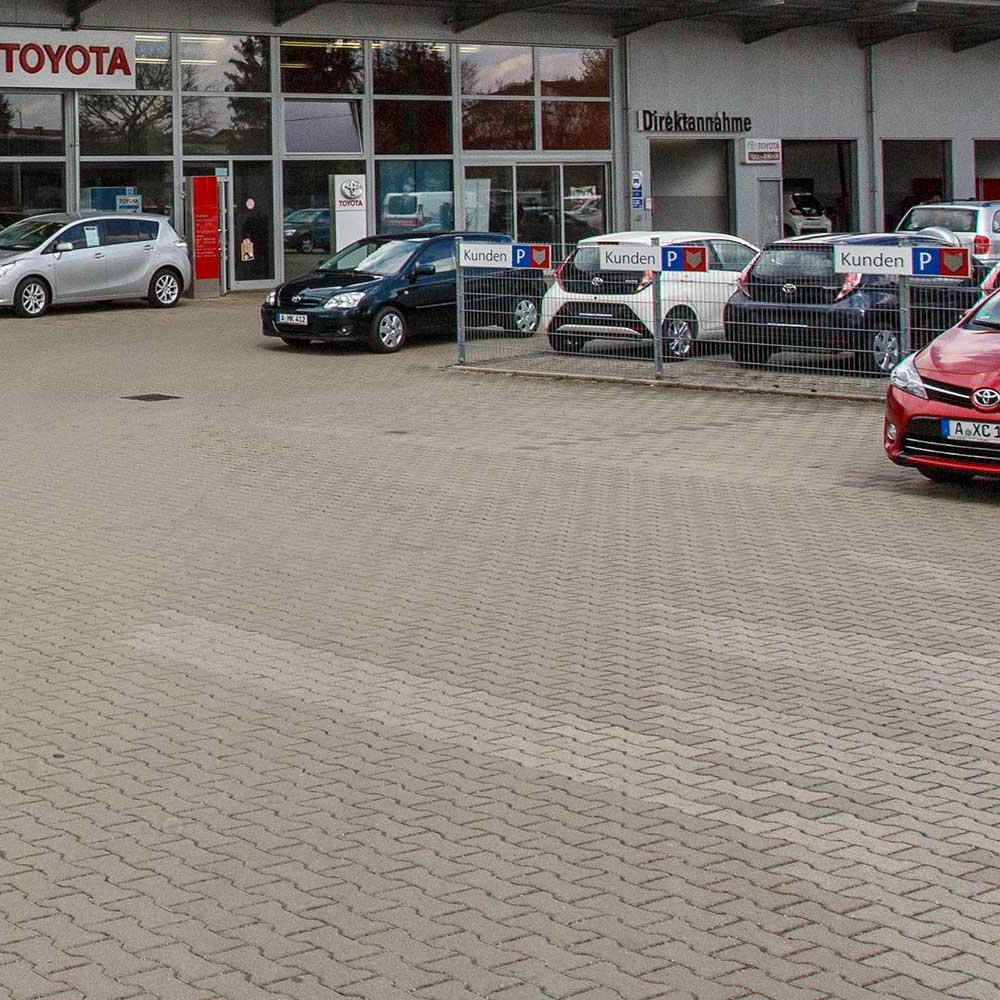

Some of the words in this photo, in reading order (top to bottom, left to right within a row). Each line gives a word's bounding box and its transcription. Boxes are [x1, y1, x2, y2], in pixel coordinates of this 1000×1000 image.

[641, 109, 752, 132] Direktannahme
[757, 142, 780, 150] TOYOTA
[338, 199, 363, 208] TOYOTA
[463, 249, 508, 262] Kunden
[604, 251, 656, 266] Kunden
[840, 252, 905, 268] Kunden
